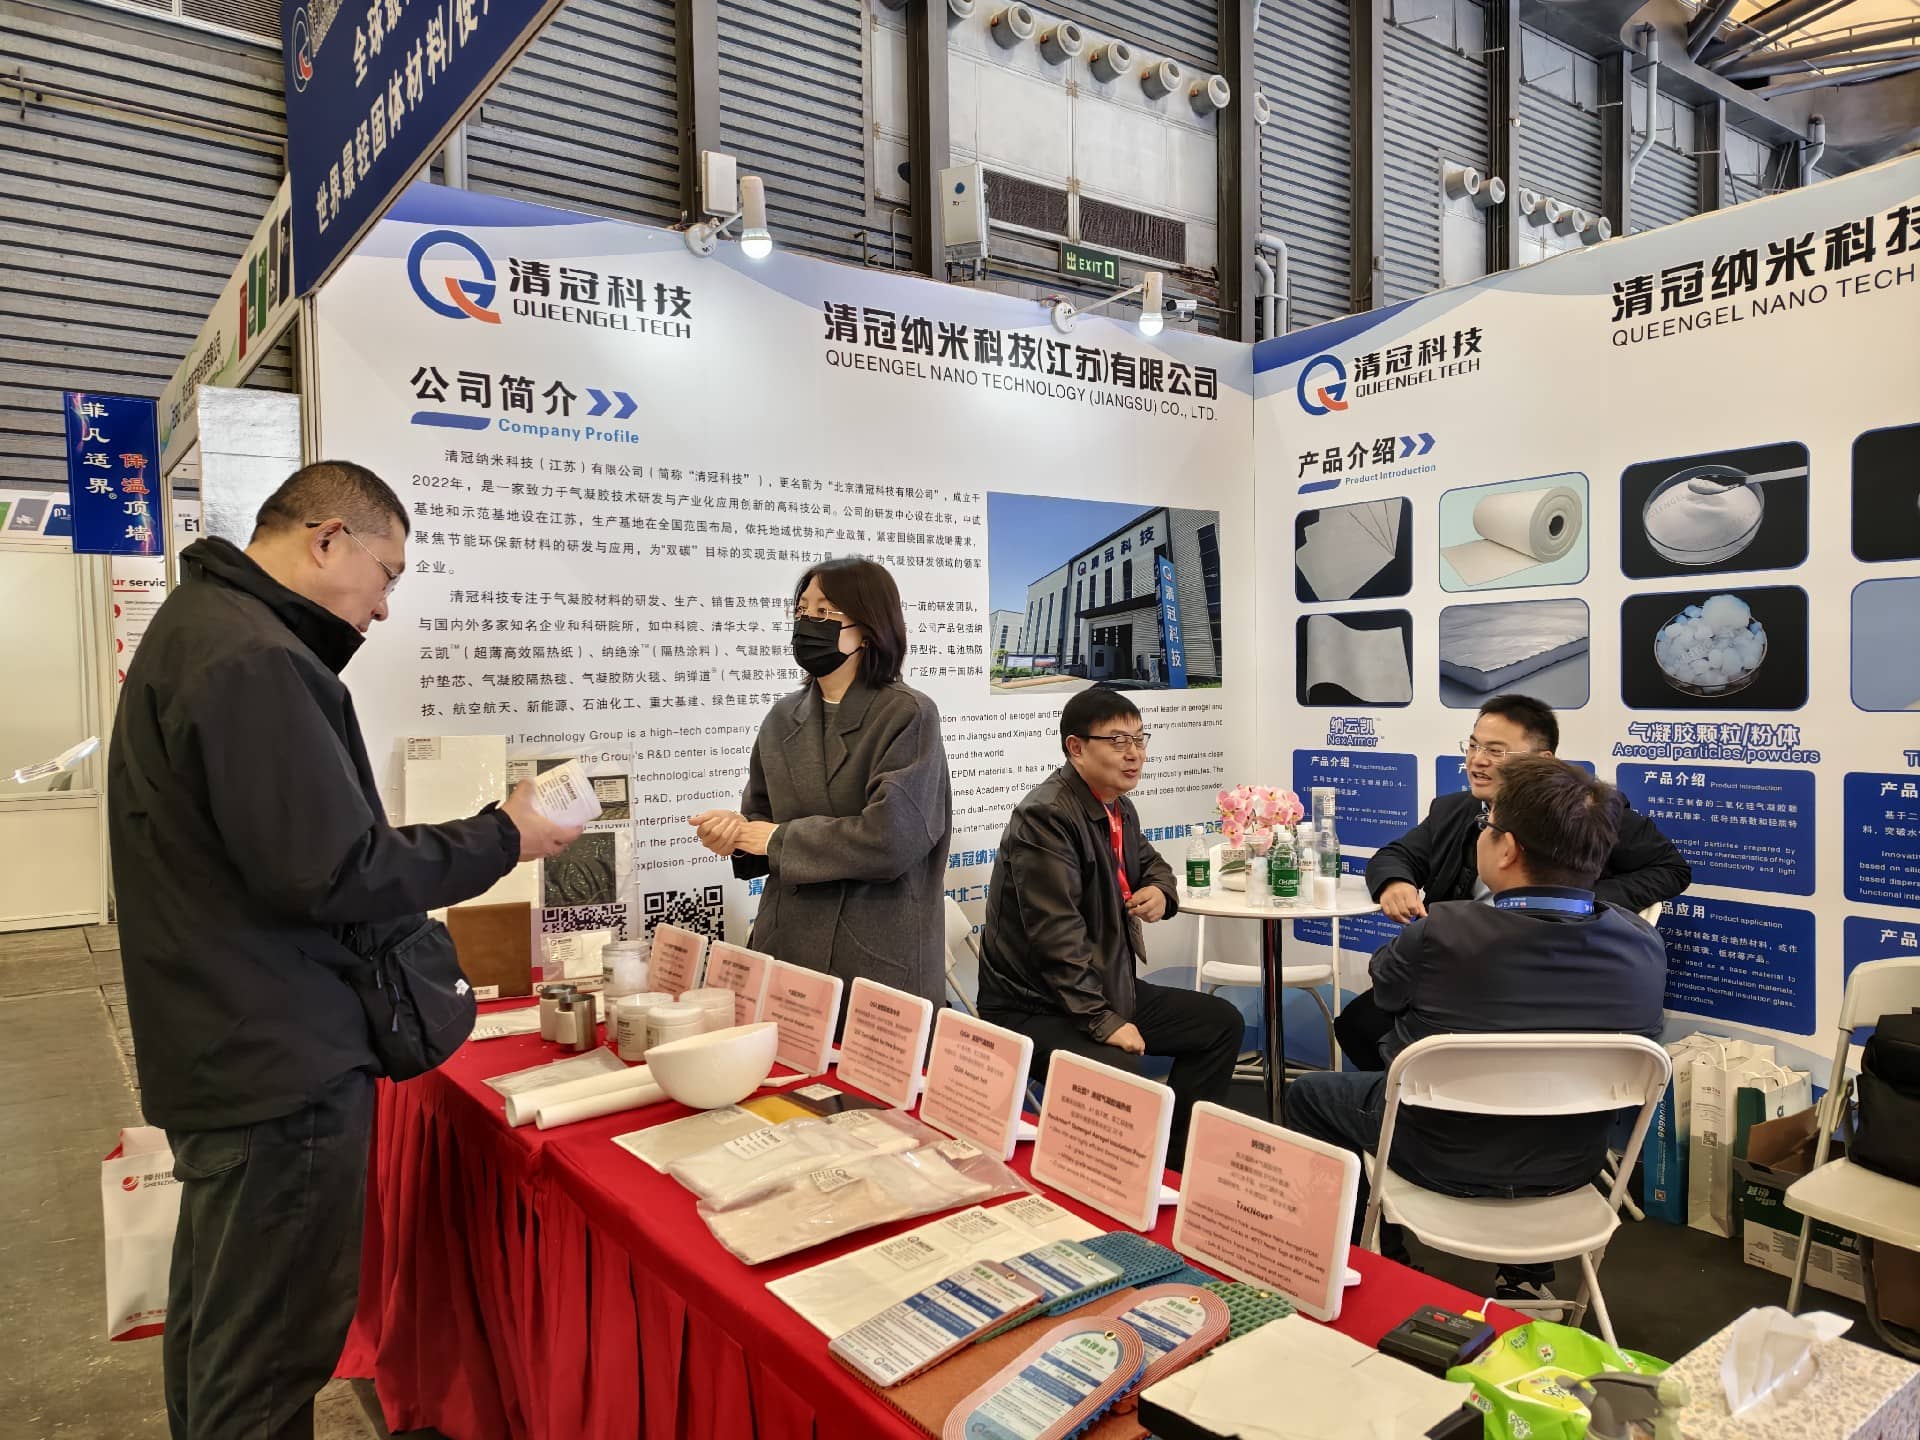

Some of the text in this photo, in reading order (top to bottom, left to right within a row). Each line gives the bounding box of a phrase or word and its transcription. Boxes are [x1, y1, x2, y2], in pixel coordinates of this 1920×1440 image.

[1066, 252, 1116, 280] 出 EXIT 口
[508, 257, 693, 319] 清冠科技
[1612, 304, 1744, 347] QUEENGEL
[1752, 285, 1828, 317] NANO
[636, 317, 691, 339] TECH
[824, 300, 1218, 400] 清冠纳米科技(江苏)有限公司
[1354, 326, 1482, 382] 清冠科技
[826, 349, 1218, 422] QUEENGEL NANO TECHNOLOGY (JIANGSU) CO., LTD.
[1356, 358, 1481, 398] QUEENGEL TECH
[410, 366, 577, 416] 公司简介
[498, 418, 640, 444] Company Profile
[1298, 436, 1396, 478] 产品介绍
[1345, 463, 1436, 486] Product Introduction
[120, 453, 152, 541] 保温顶墙
[416, 560, 455, 575] 企业。
[1000, 711, 1007, 721] of
[519, 732, 585, 744] Technology
[589, 730, 623, 742] Group
[627, 728, 637, 738] is
[640, 730, 646, 738] a
[705, 725, 750, 737] company
[967, 731, 996, 742] Jiangsu
[997, 730, 1012, 739] and
[1327, 734, 1379, 747] NexArmor
[1628, 721, 1801, 748] 气凝胶颗粒/粉体
[580, 753, 598, 763] the
[601, 751, 644, 764] Grou's
[647, 749, 671, 760] R&D
[674, 748, 706, 758] center
[710, 746, 719, 756] is
[947, 751, 969, 760] round
[1311, 756, 1350, 768] 产品介绍
[1612, 743, 1821, 765] Aerogel particles/powders
[951, 768, 976, 779] EPDM
[1644, 771, 1706, 787] 产品介绍
[953, 788, 974, 797] inese
[1862, 824, 1920, 838] 料，突破水
[637, 838, 667, 849] in the
[1859, 861, 1886, 871] based
[1859, 875, 1886, 885] based
[1660, 900, 1705, 919] 品应用
[1710, 913, 1783, 929] Product application
[1880, 929, 1918, 948] 产品
